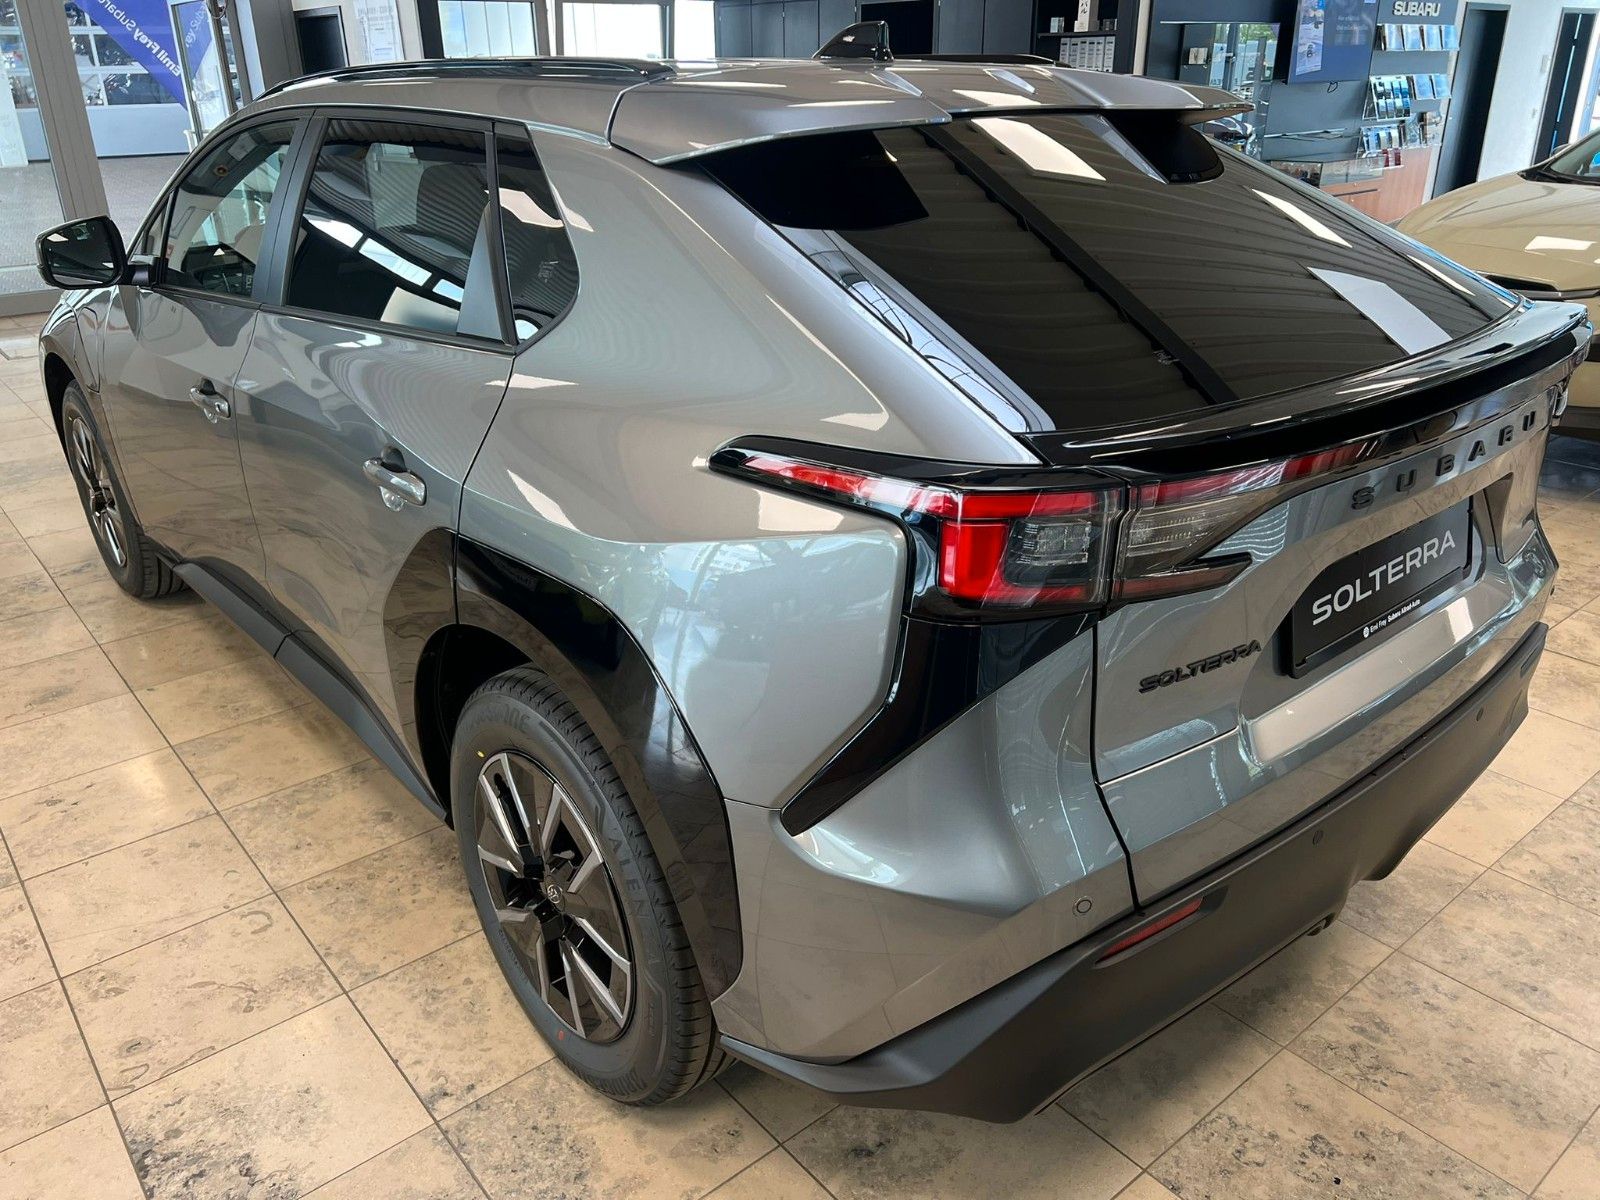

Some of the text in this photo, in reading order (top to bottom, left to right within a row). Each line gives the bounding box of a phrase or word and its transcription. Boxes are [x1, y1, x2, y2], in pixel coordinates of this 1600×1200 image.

[1393, 1, 1441, 17] SUBARU
[1351, 411, 1537, 511] SUBARU
[1312, 529, 1456, 626] SOLTERRA
[1138, 639, 1262, 694] SOLTERRA
